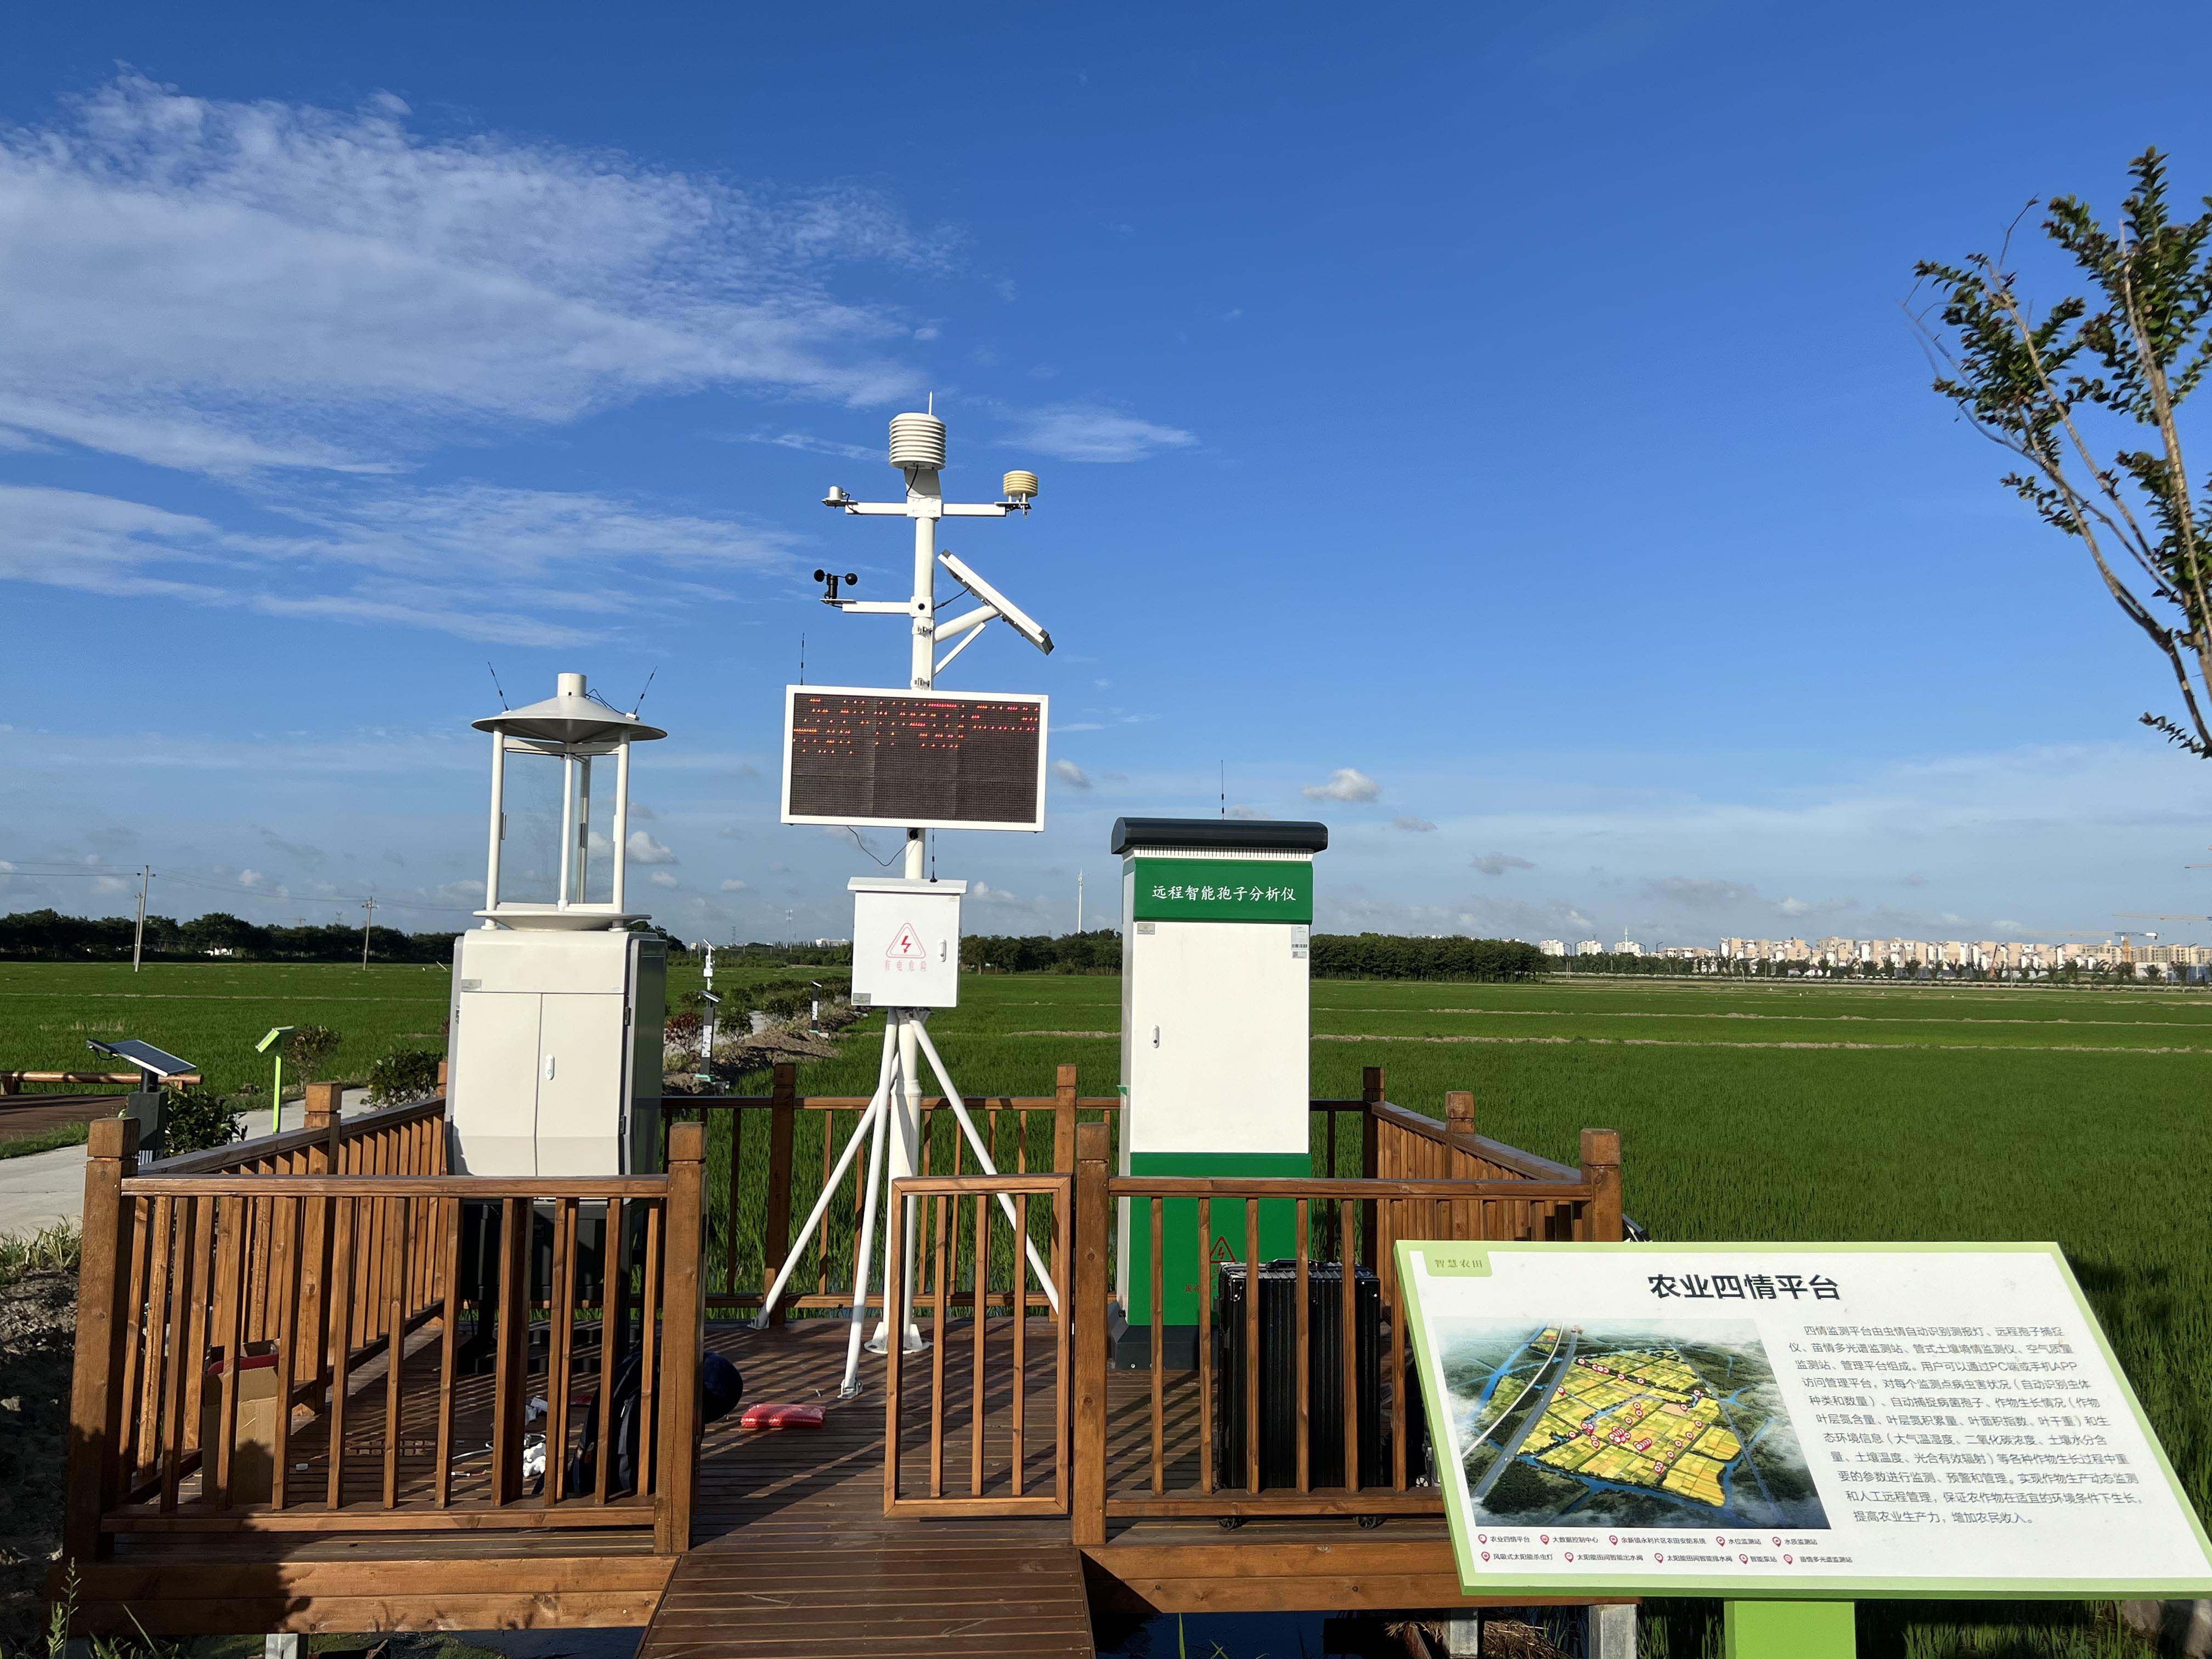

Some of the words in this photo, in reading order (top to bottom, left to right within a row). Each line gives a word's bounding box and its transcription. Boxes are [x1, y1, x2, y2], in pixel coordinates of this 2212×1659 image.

[1152, 884, 1297, 902] 远程智能孢子分析仪
[1434, 1259, 1483, 1268] 智慧农田
[1647, 1273, 1842, 1301] 农业四情平台
[1804, 1325, 2064, 1337] 四情监测平台由虫情自动识别测报灯、远程孢子捕捉
